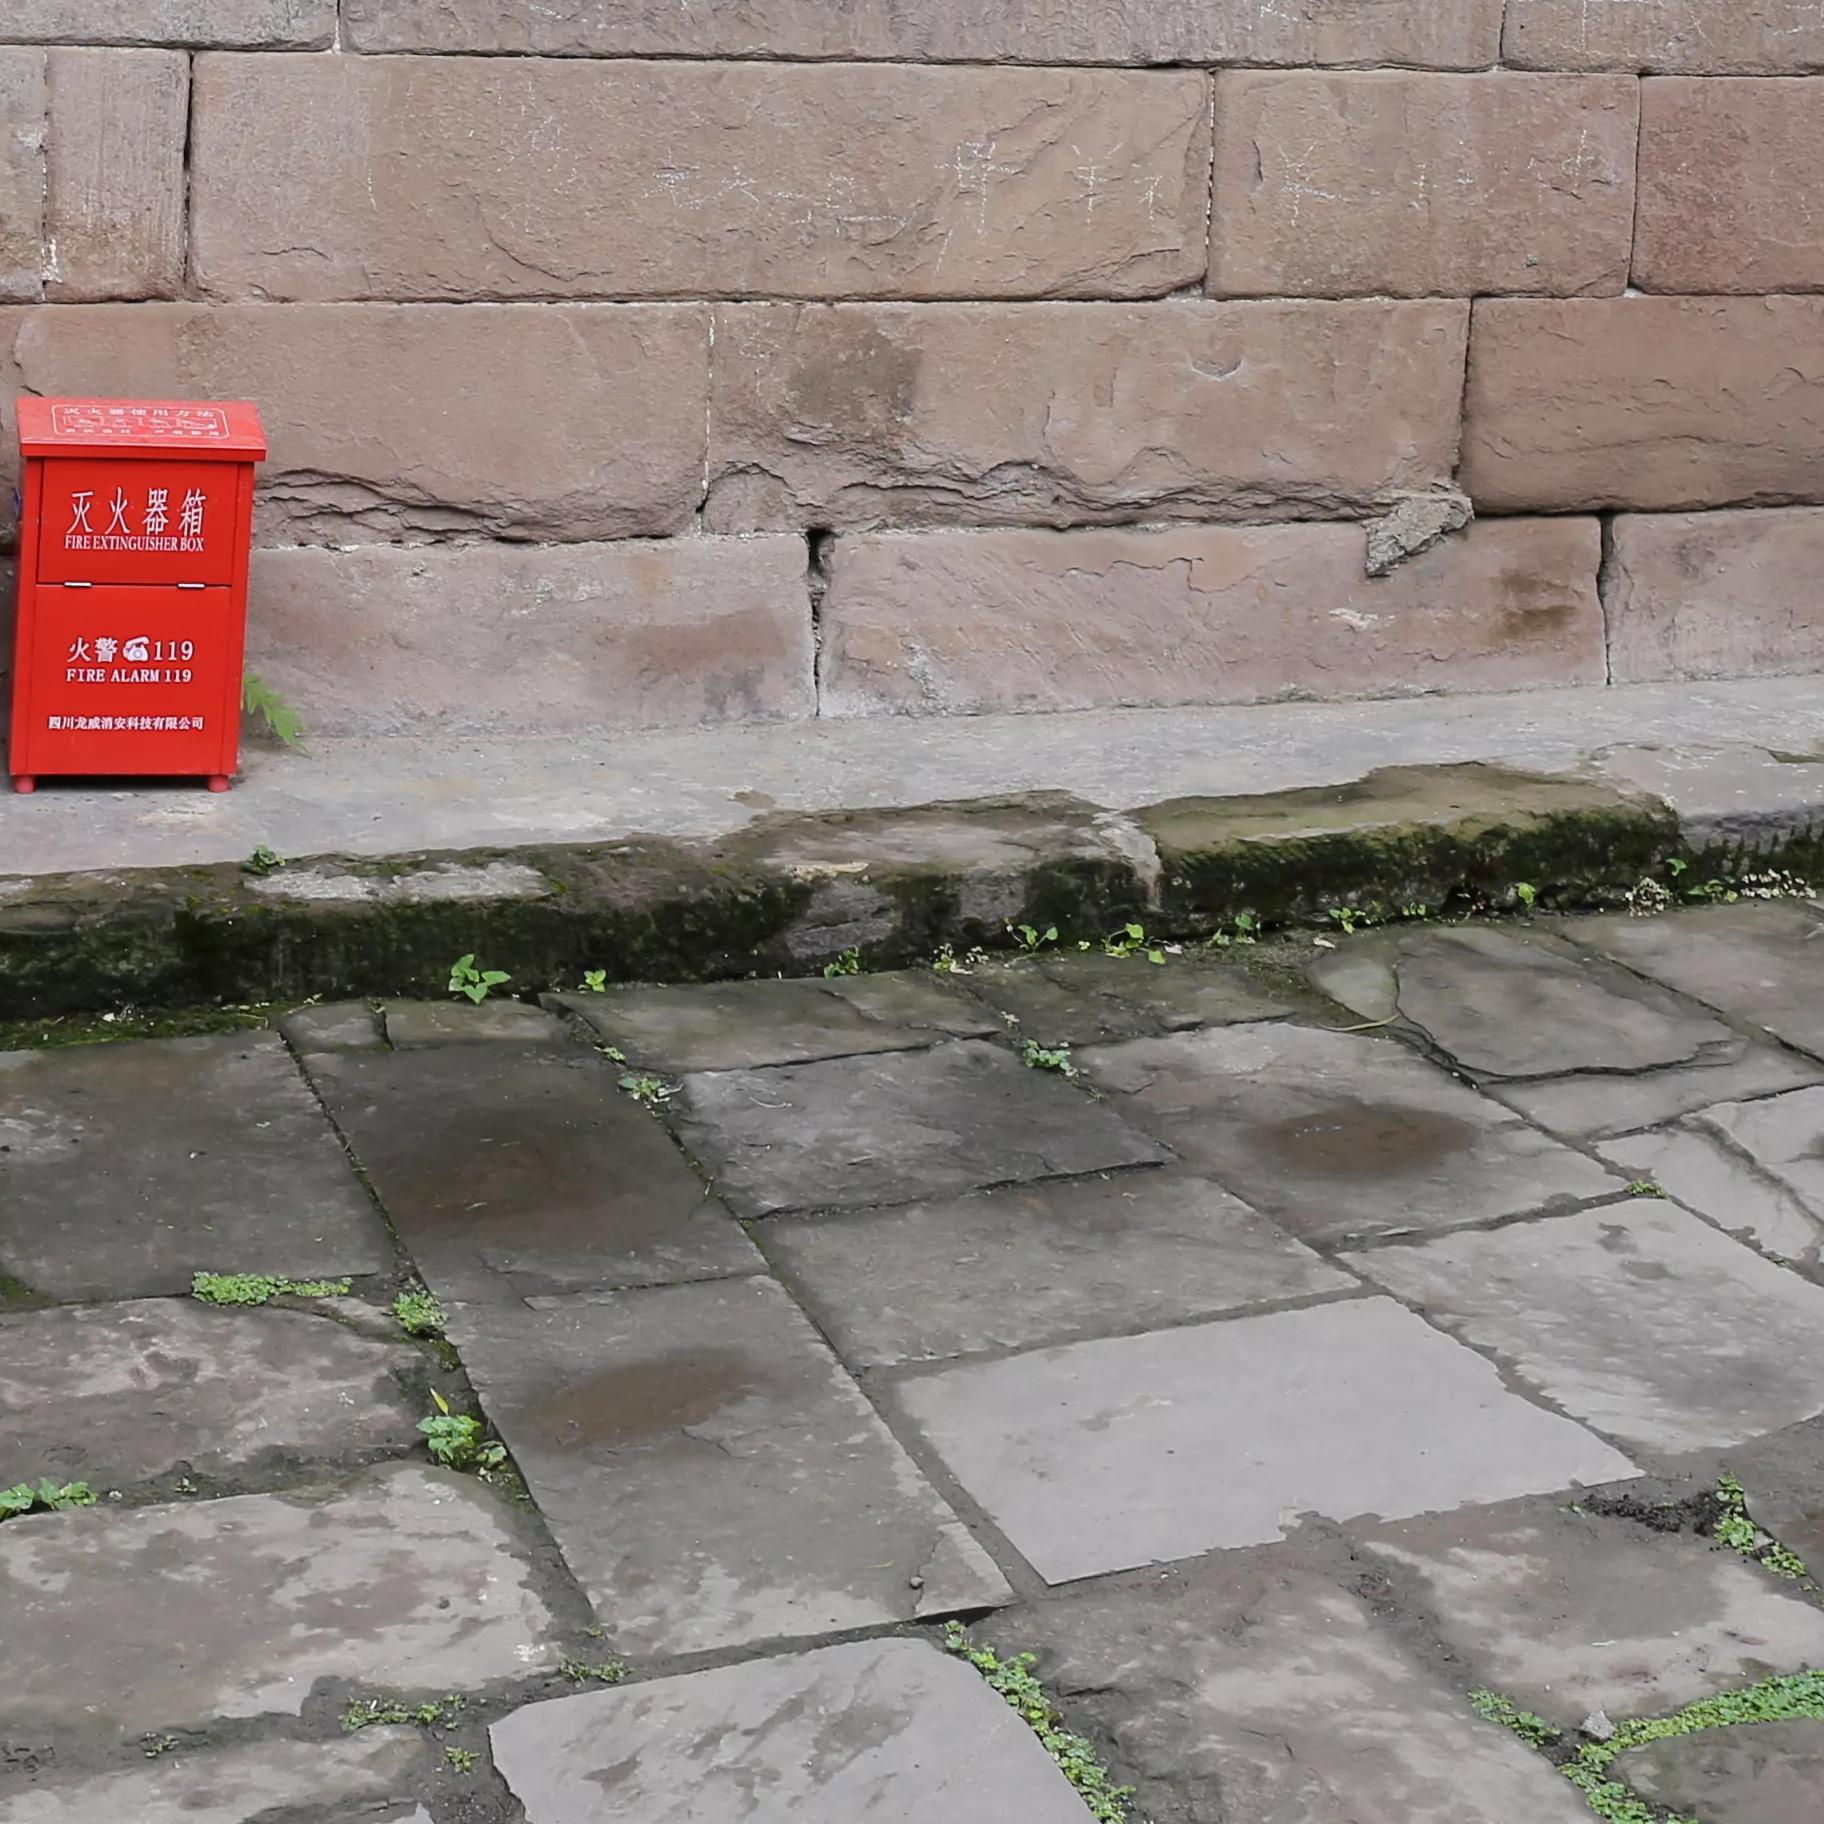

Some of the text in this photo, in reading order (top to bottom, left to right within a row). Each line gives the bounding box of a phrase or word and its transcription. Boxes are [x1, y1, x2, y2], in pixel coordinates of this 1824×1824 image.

[66, 486, 207, 536] 灭火器箱
[64, 534, 205, 553] FIRE EXTINGUISHER BOX
[66, 636, 194, 663] 火警 119
[66, 668, 193, 684] FIRE ALARM 119
[47, 715, 205, 731] 四川龙威消安科技有限公司
